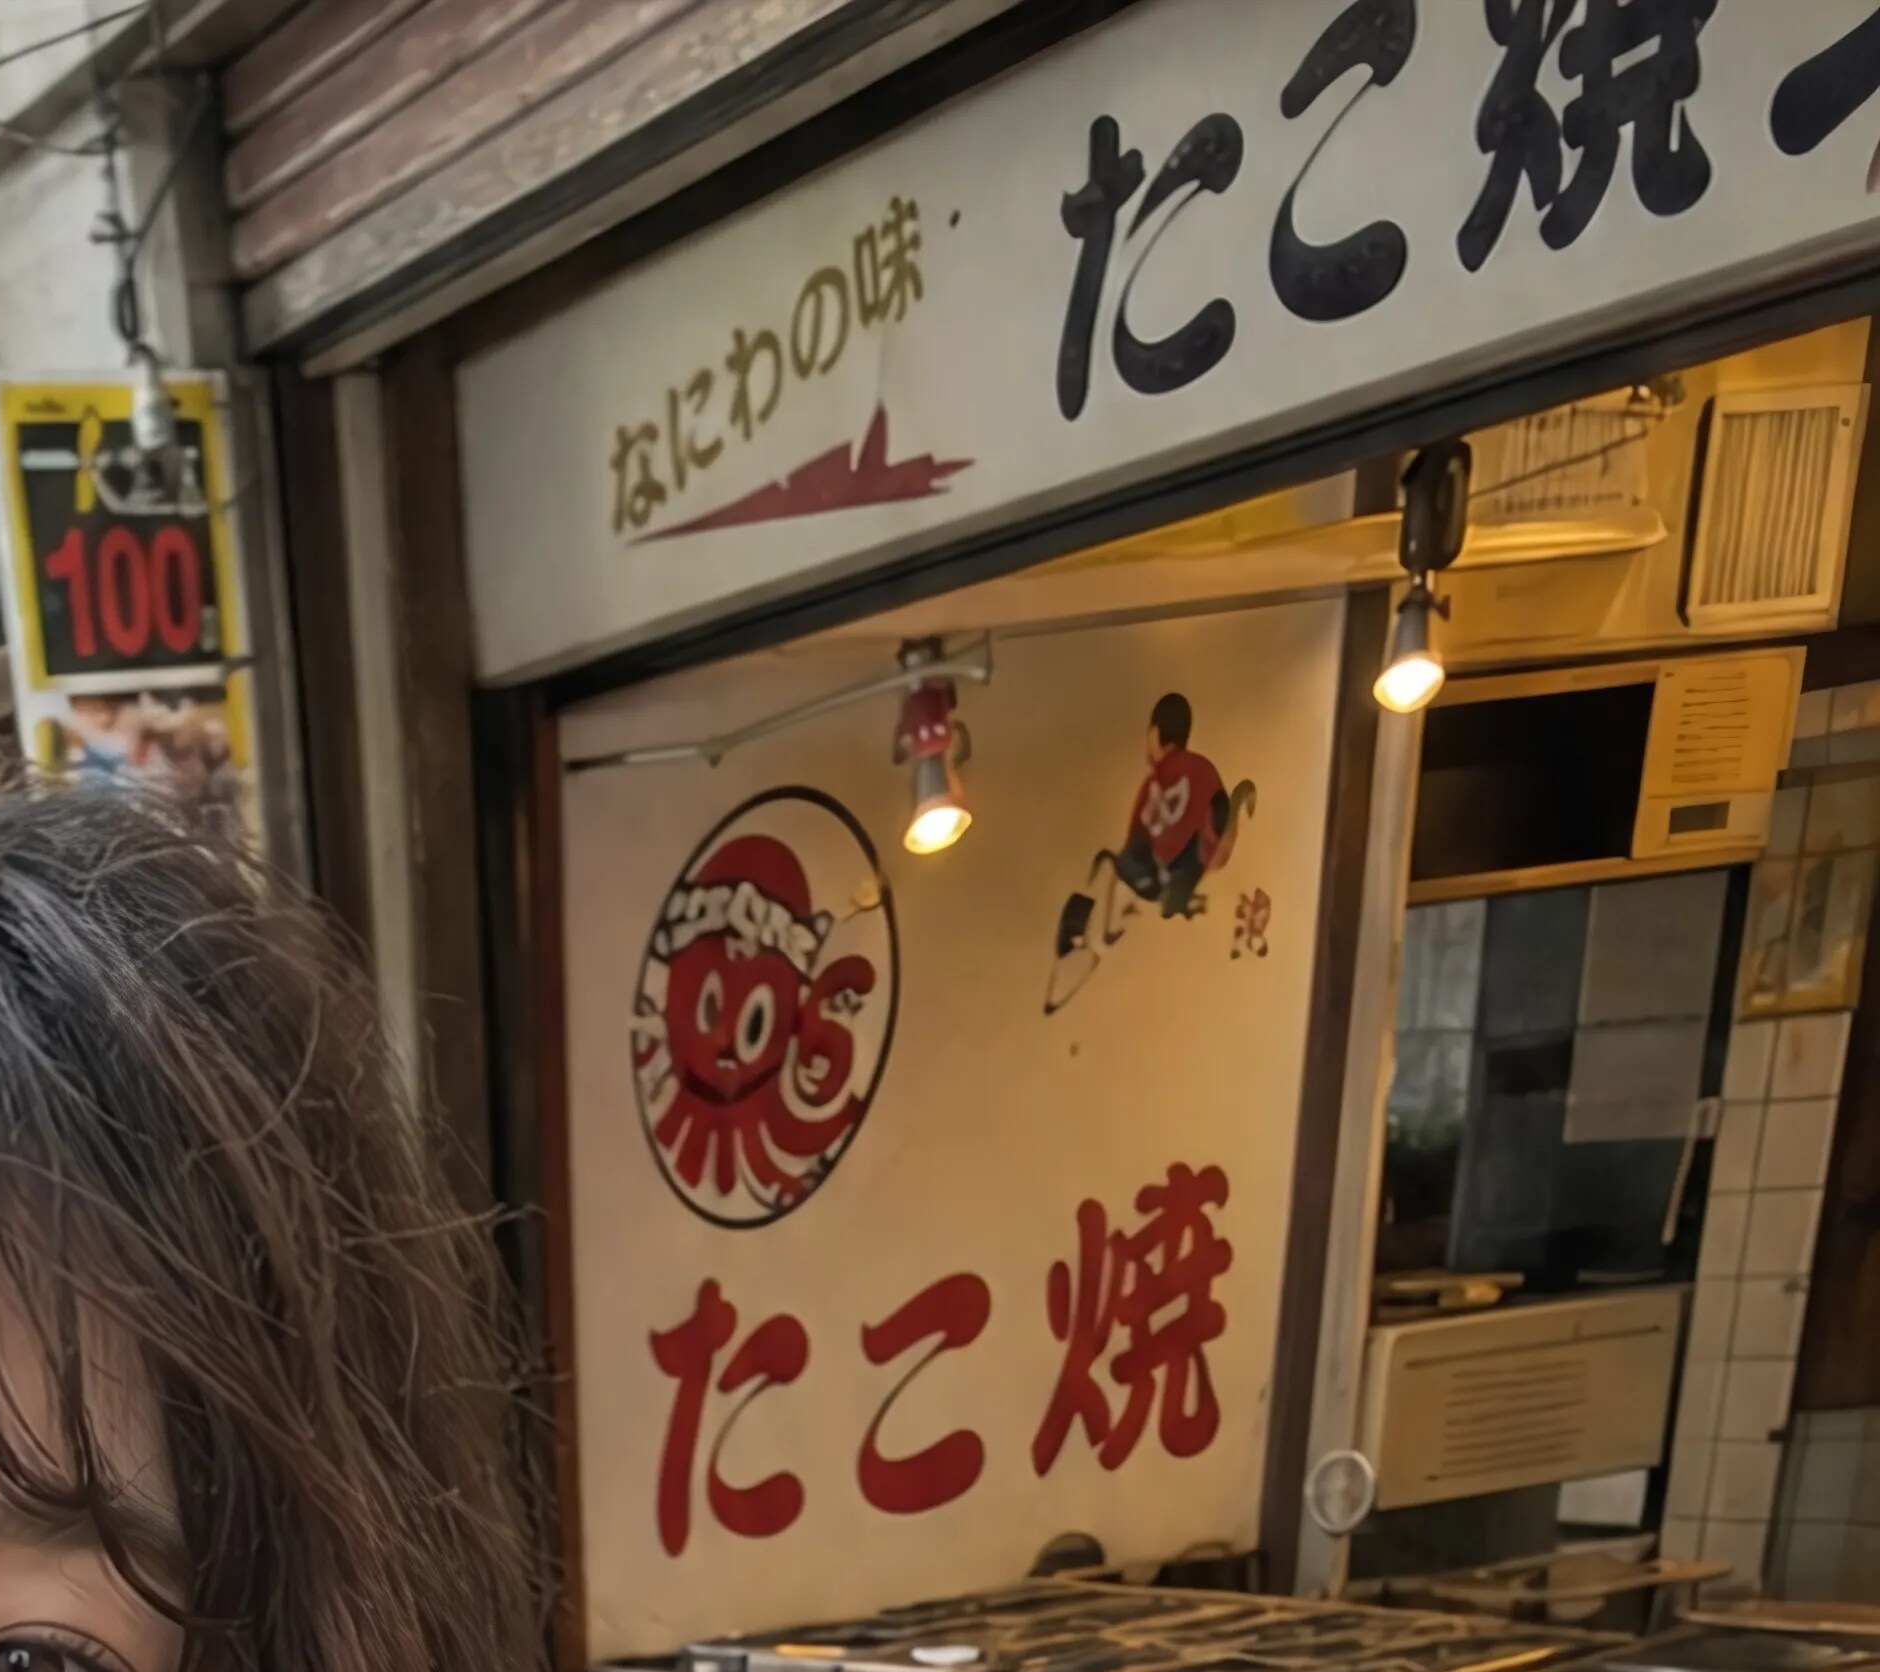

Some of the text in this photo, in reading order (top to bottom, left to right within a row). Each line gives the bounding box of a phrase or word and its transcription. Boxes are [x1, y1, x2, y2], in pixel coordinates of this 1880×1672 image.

[609, 196, 924, 535] なにわの味
[1056, 0, 1880, 421] たこ焼
[44, 525, 201, 657] 100
[650, 1161, 1234, 1559] たこ焼
